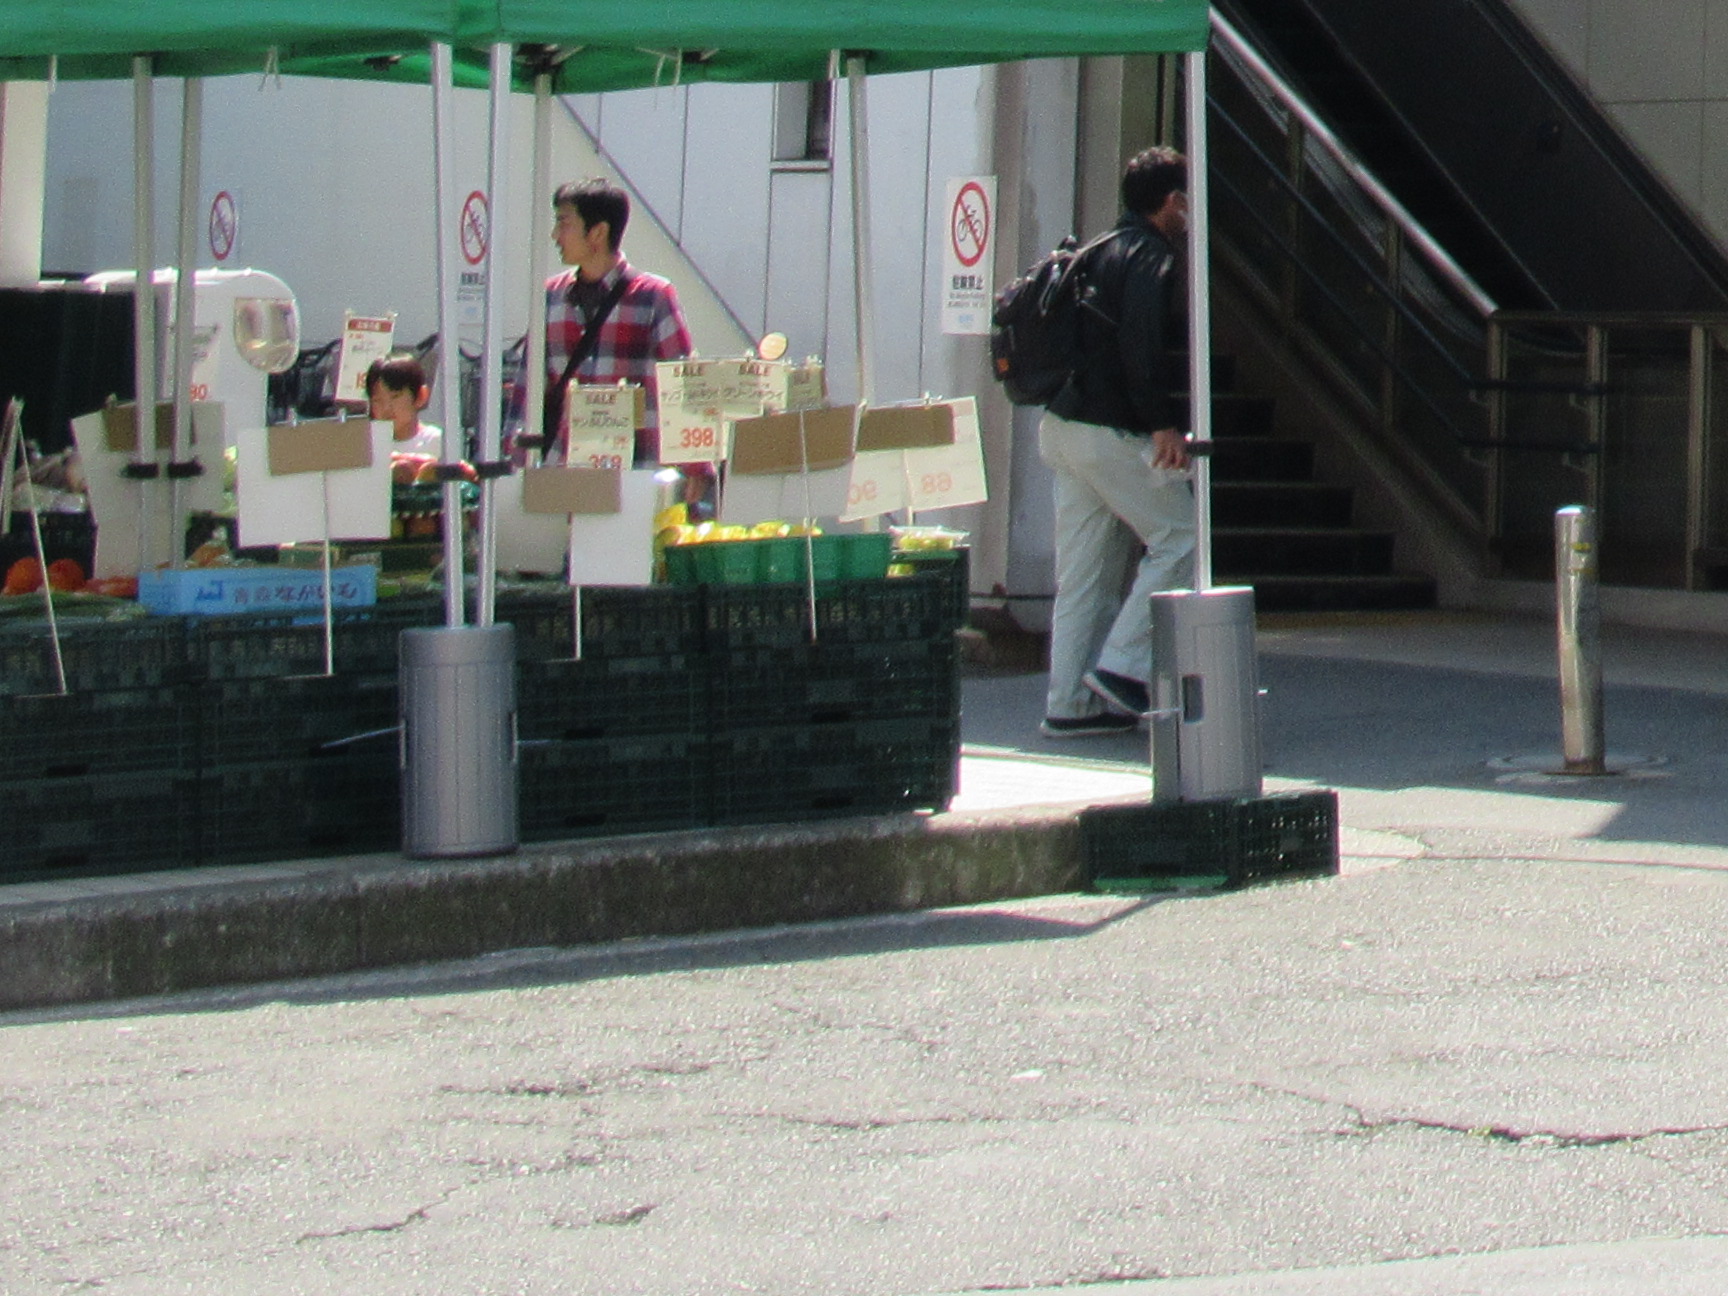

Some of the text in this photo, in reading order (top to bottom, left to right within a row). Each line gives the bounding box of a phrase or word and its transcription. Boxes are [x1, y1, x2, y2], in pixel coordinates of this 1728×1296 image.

[739, 363, 770, 376] SALE
[586, 392, 617, 405] SALE
[681, 427, 714, 448] 398
